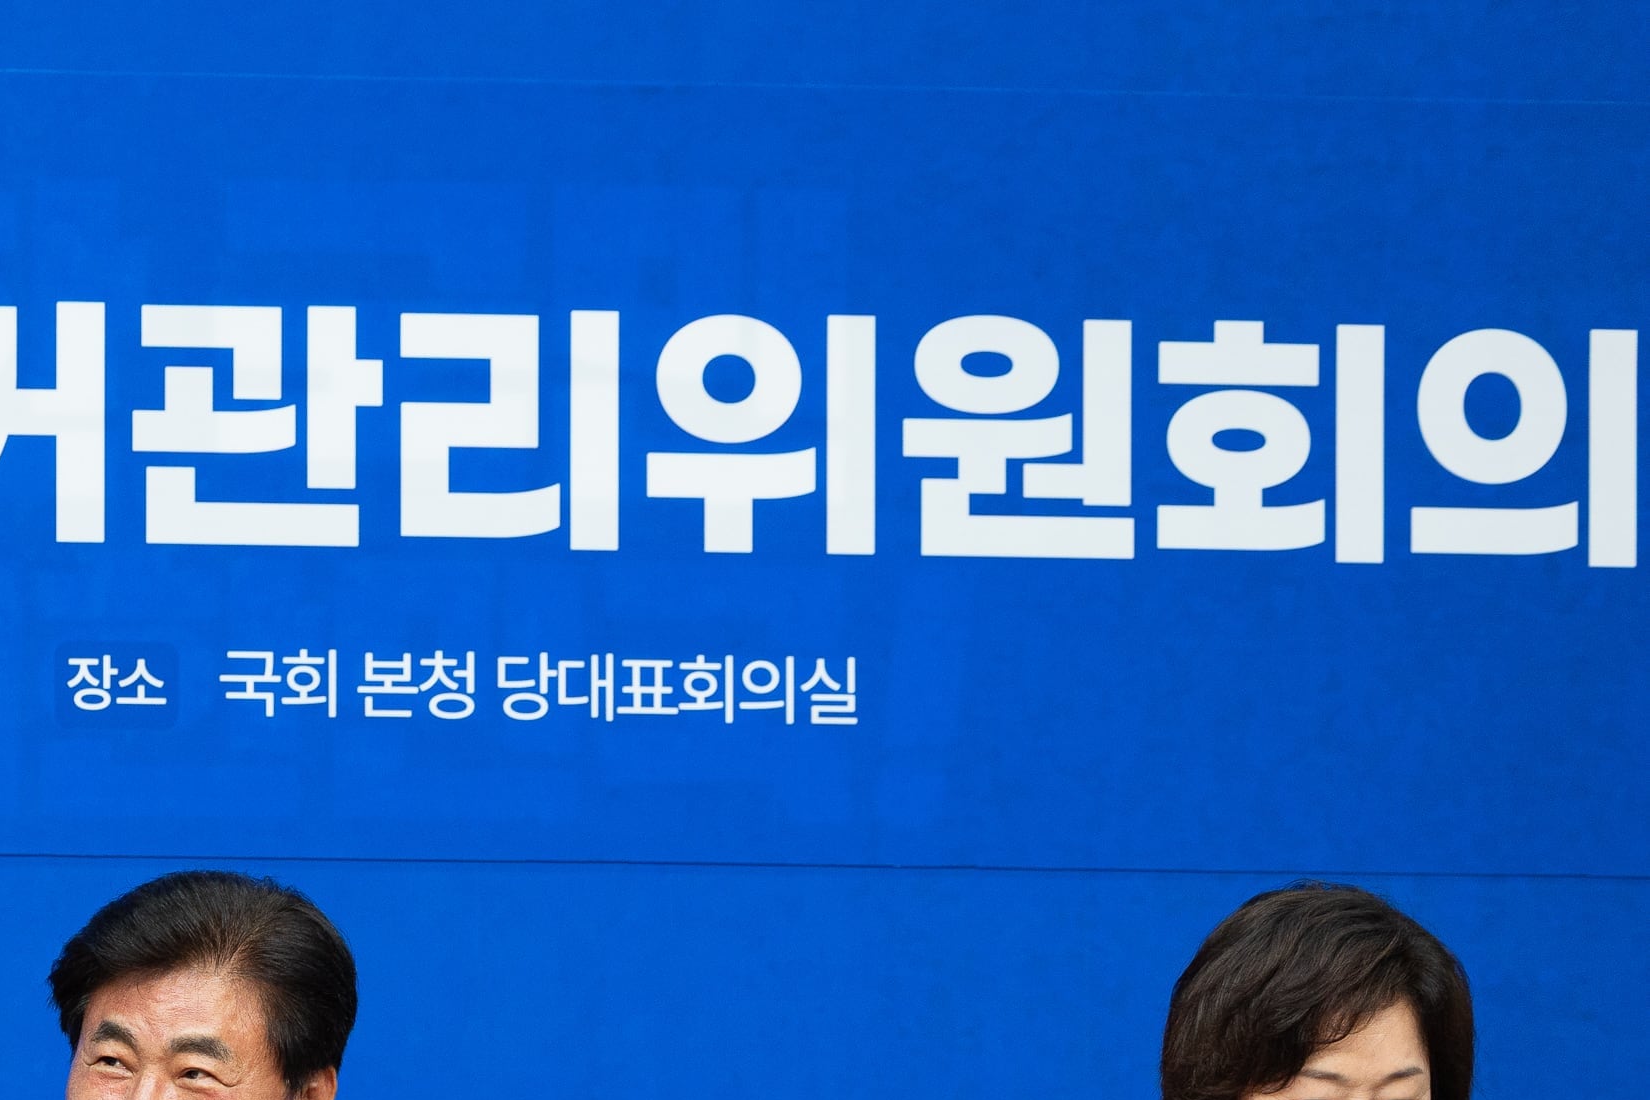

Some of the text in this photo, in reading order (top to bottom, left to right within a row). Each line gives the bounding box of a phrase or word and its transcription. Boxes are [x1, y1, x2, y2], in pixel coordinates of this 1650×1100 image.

[68, 655, 166, 710] 장소
[220, 649, 858, 724] 국회 본청 당대표회의실
